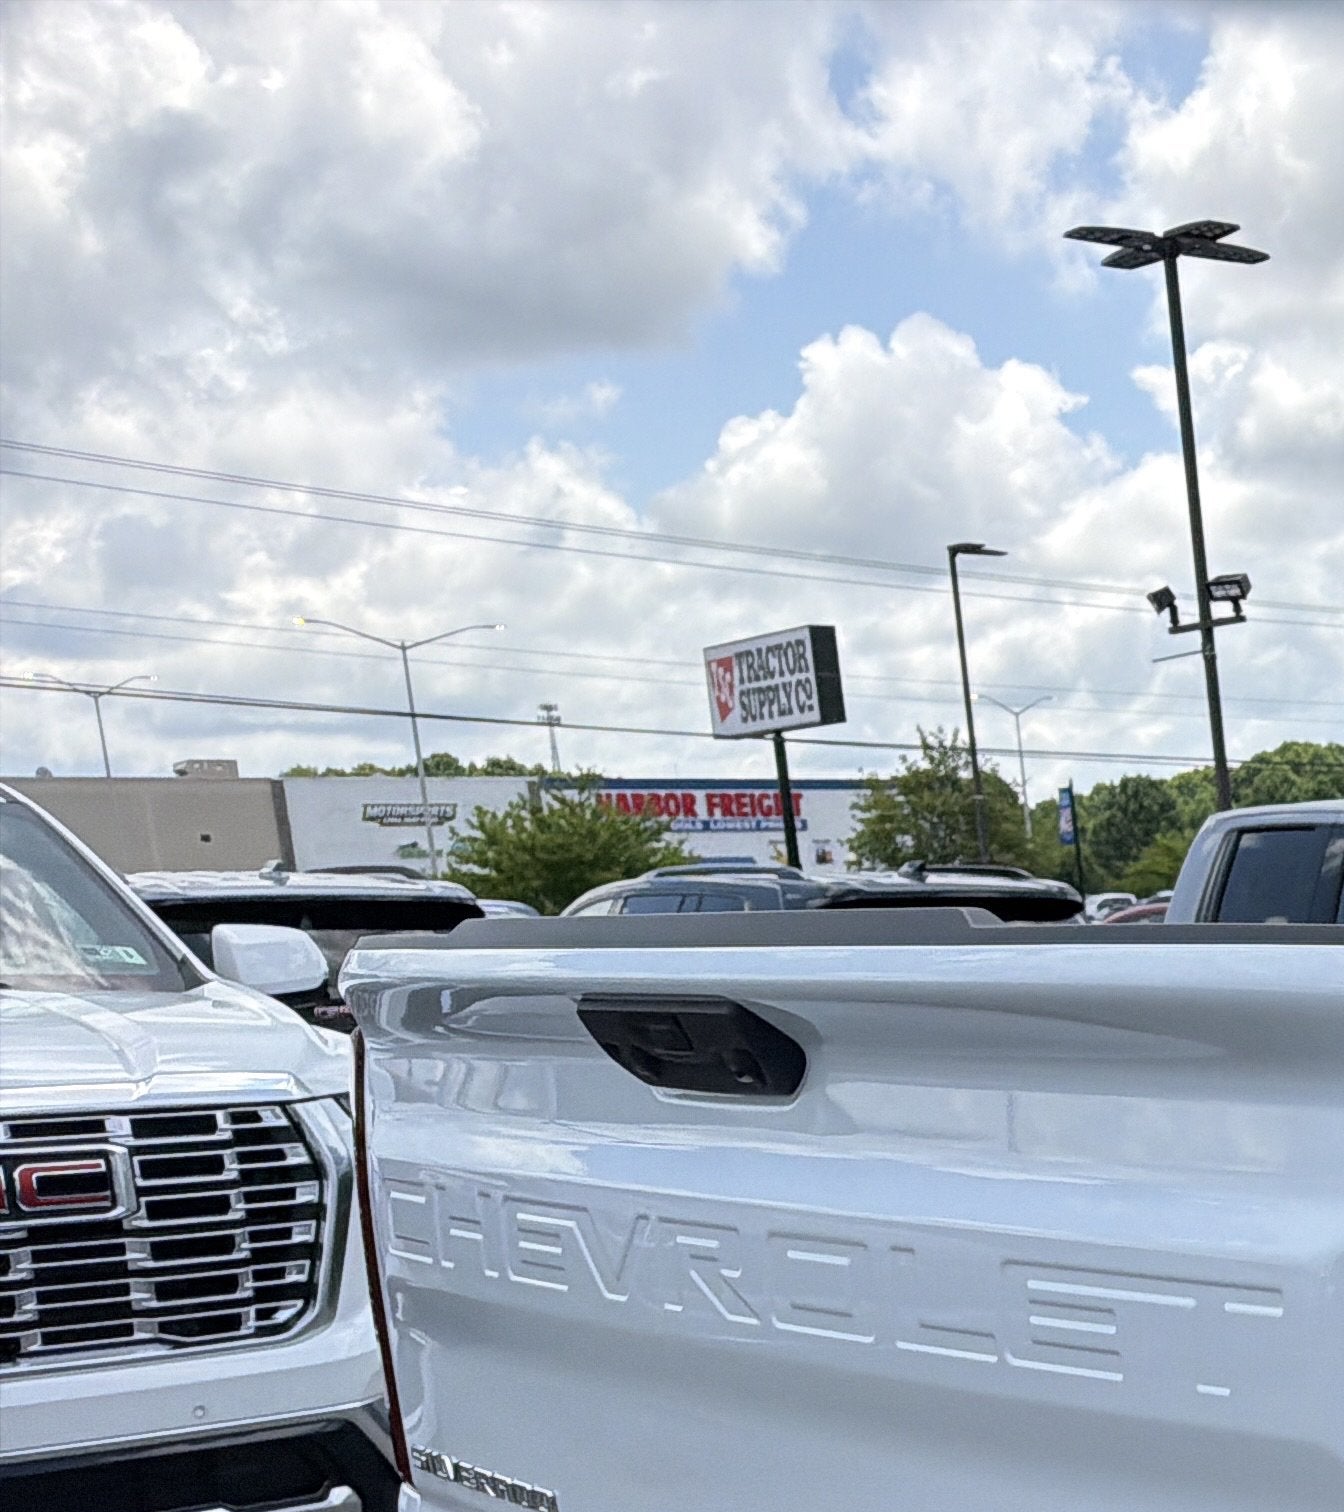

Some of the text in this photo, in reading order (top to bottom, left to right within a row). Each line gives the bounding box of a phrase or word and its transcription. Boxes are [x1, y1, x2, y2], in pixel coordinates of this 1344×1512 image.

[734, 639, 810, 685] TRACTOR
[738, 681, 794, 723] SUPPLY
[382, 1174, 1285, 1396] CHEVROLET
